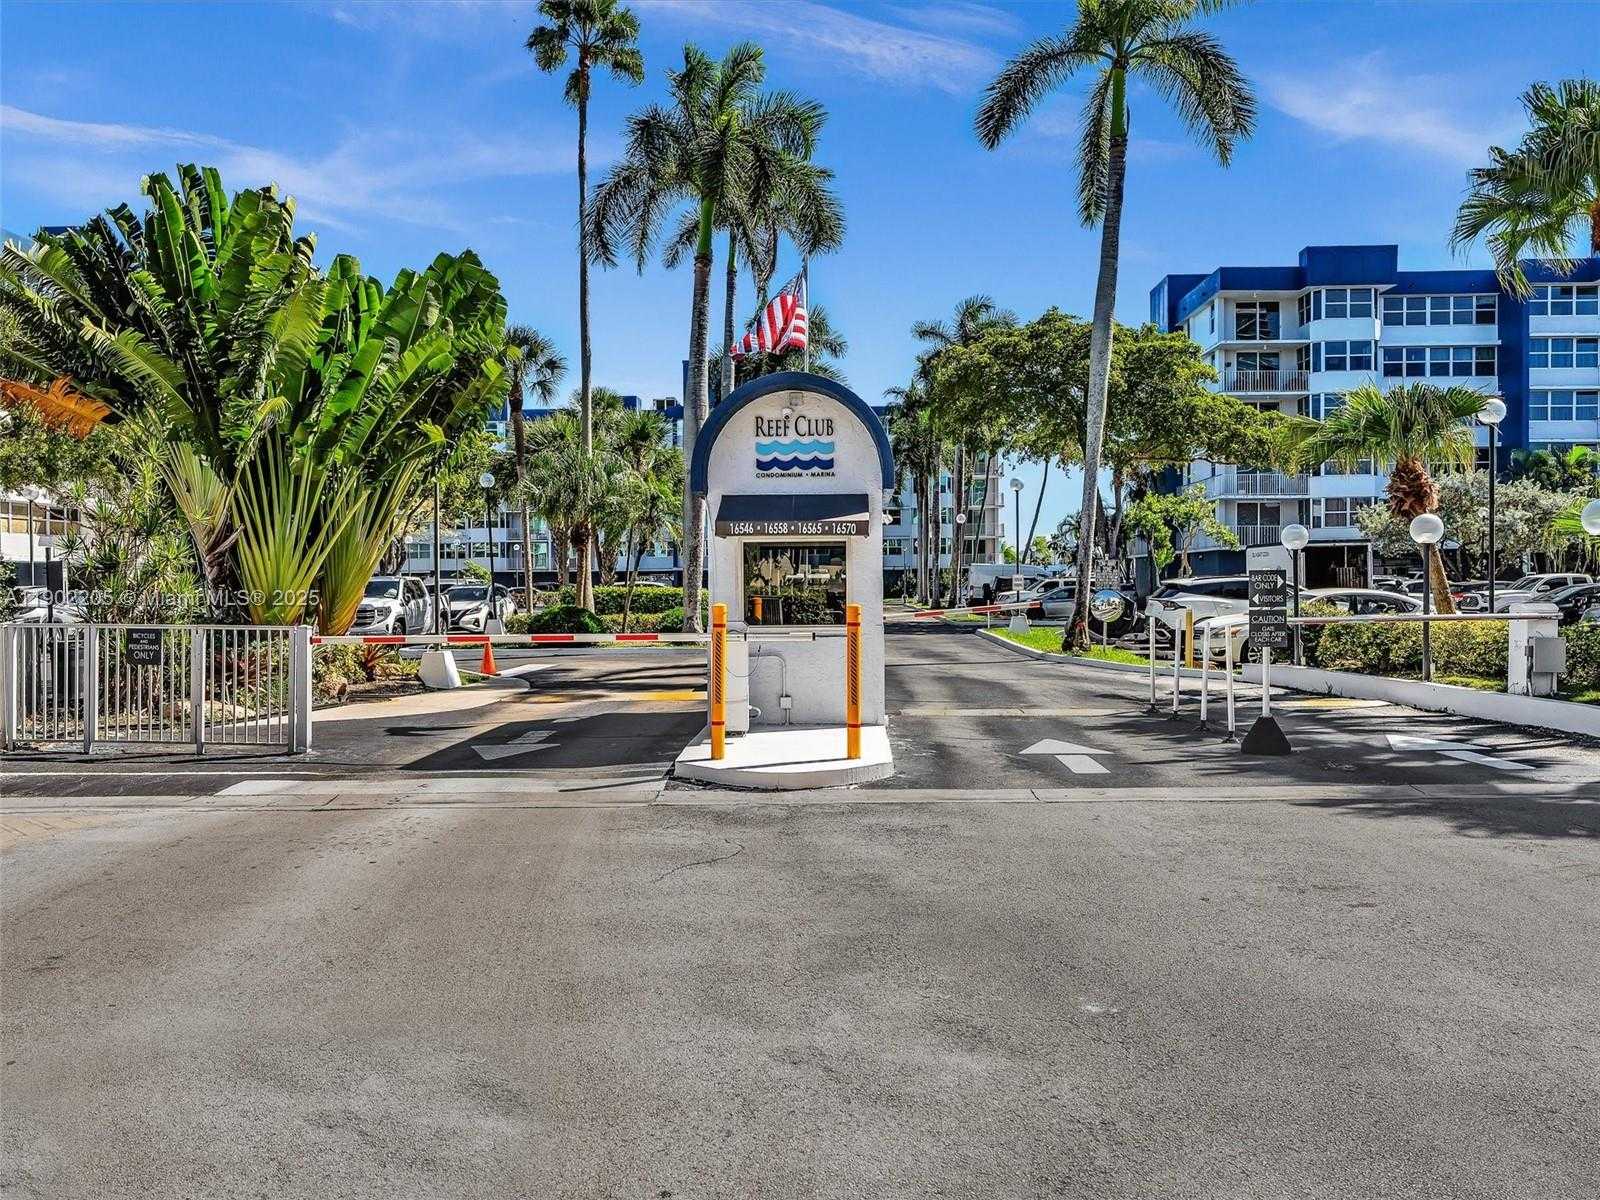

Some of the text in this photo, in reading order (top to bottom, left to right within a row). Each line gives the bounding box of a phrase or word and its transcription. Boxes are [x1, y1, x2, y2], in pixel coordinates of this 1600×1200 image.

[754, 415, 834, 437] REEF CLUB
[729, 522, 857, 534] 16546 16558 16565 16570
[1251, 574, 1262, 582] BAR
[1254, 582, 1275, 590] ONLY
[1259, 594, 1284, 603] VISITORS
[1251, 615, 1285, 624] CAUTION
[133, 650, 155, 660] ONLY
